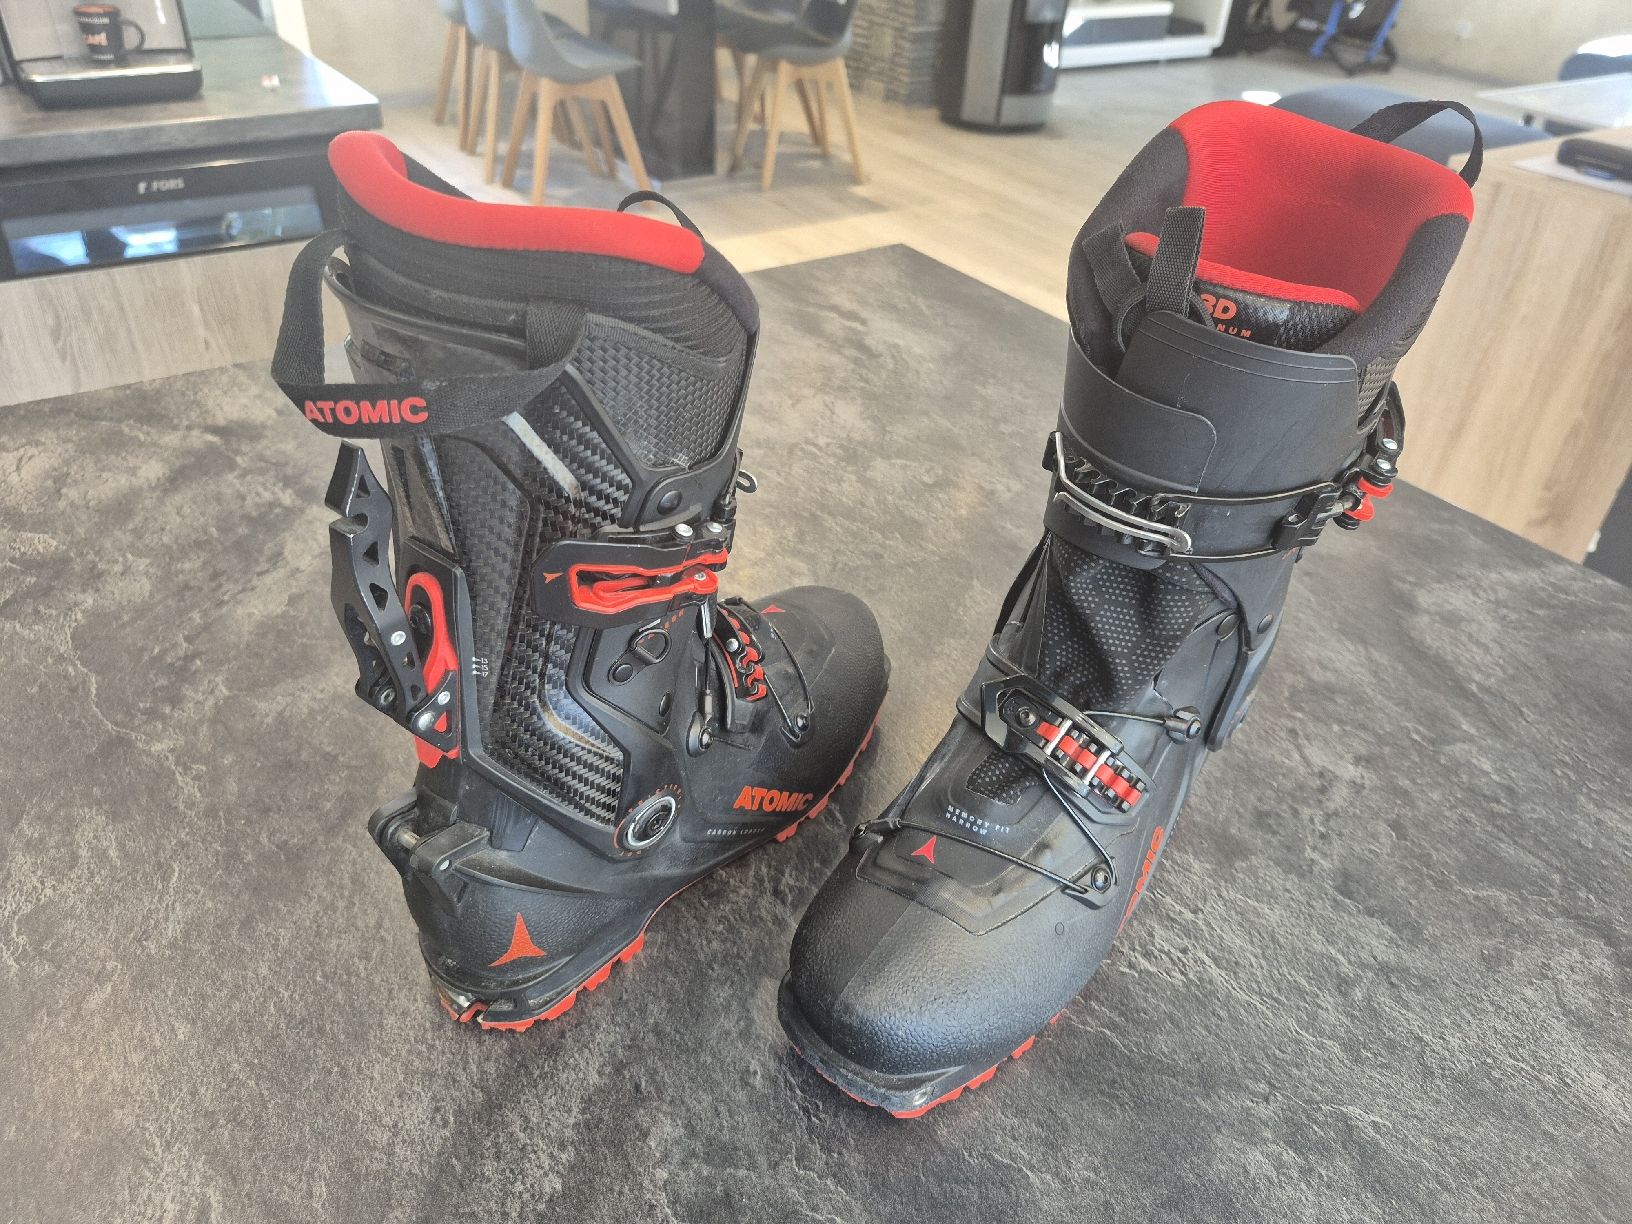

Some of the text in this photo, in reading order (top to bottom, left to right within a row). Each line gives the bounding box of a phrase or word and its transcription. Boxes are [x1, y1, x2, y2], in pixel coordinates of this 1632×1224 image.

[304, 396, 428, 425] ATOMIC
[732, 785, 814, 813] ATOMIC
[706, 828, 737, 836] CARBON
[945, 811, 988, 836] NARROW
[947, 804, 1010, 835] MEMORY FIT
